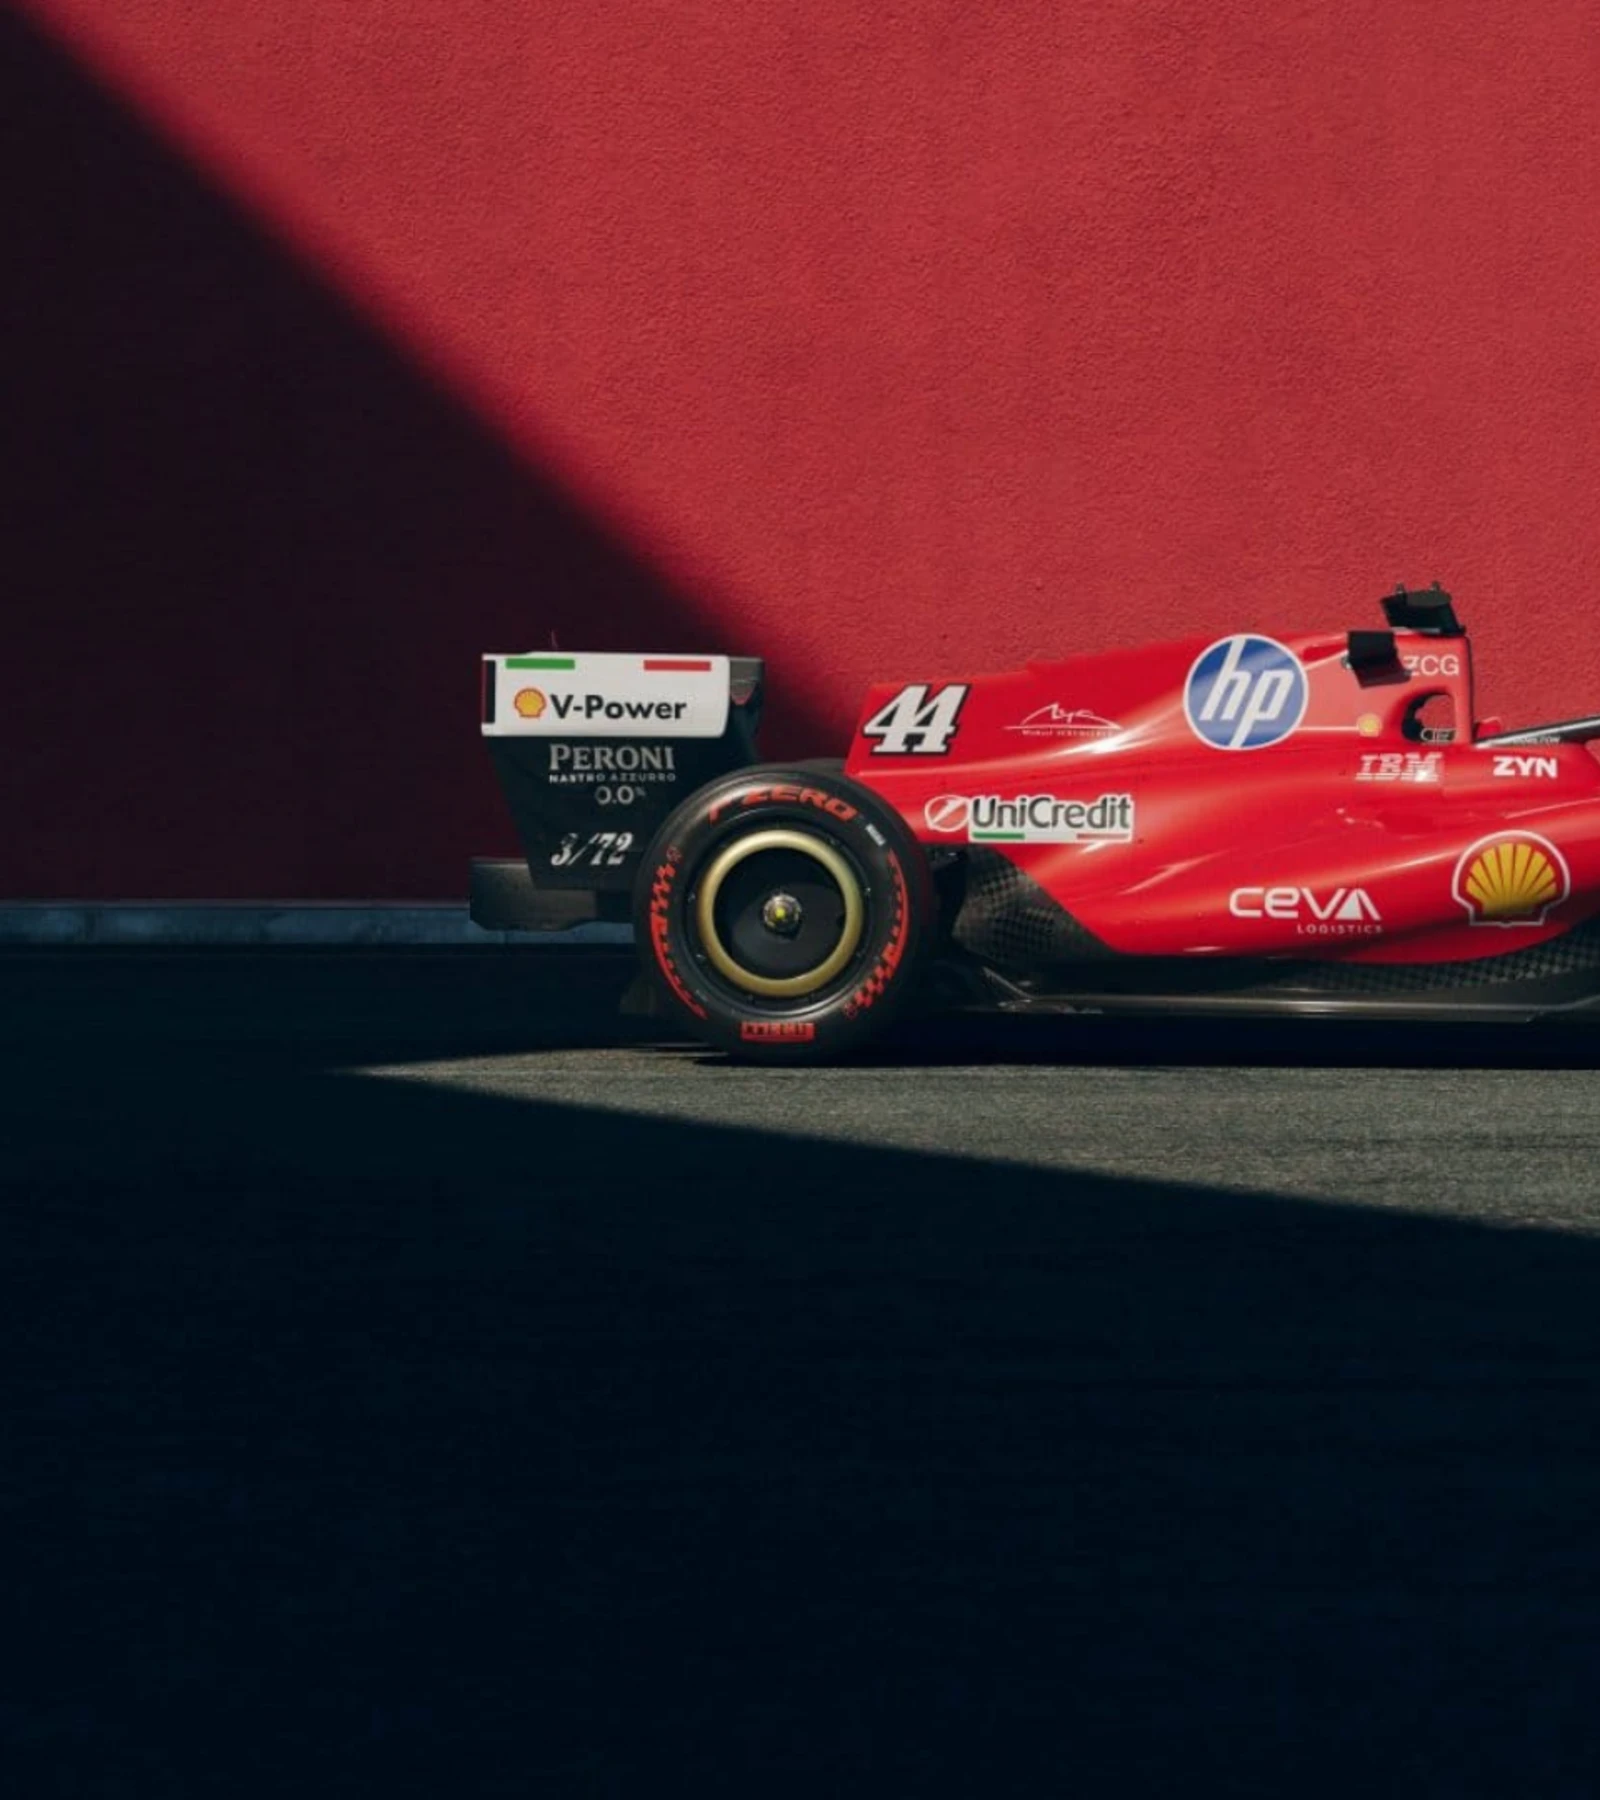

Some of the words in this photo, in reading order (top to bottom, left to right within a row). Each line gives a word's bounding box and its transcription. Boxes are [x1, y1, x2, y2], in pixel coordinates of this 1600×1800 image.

[1199, 635, 1295, 748] hp
[550, 694, 687, 719] V-Power
[862, 684, 970, 754] 44
[549, 743, 676, 771] PERONI
[1355, 753, 1443, 782] IBM
[1493, 756, 1558, 778] ZYN
[549, 774, 606, 783] NASTRO
[609, 773, 676, 782] AZZURRO
[972, 797, 1131, 829] UniCredit
[550, 832, 634, 866] 3/72
[1297, 924, 1383, 934] LOGISTICS
